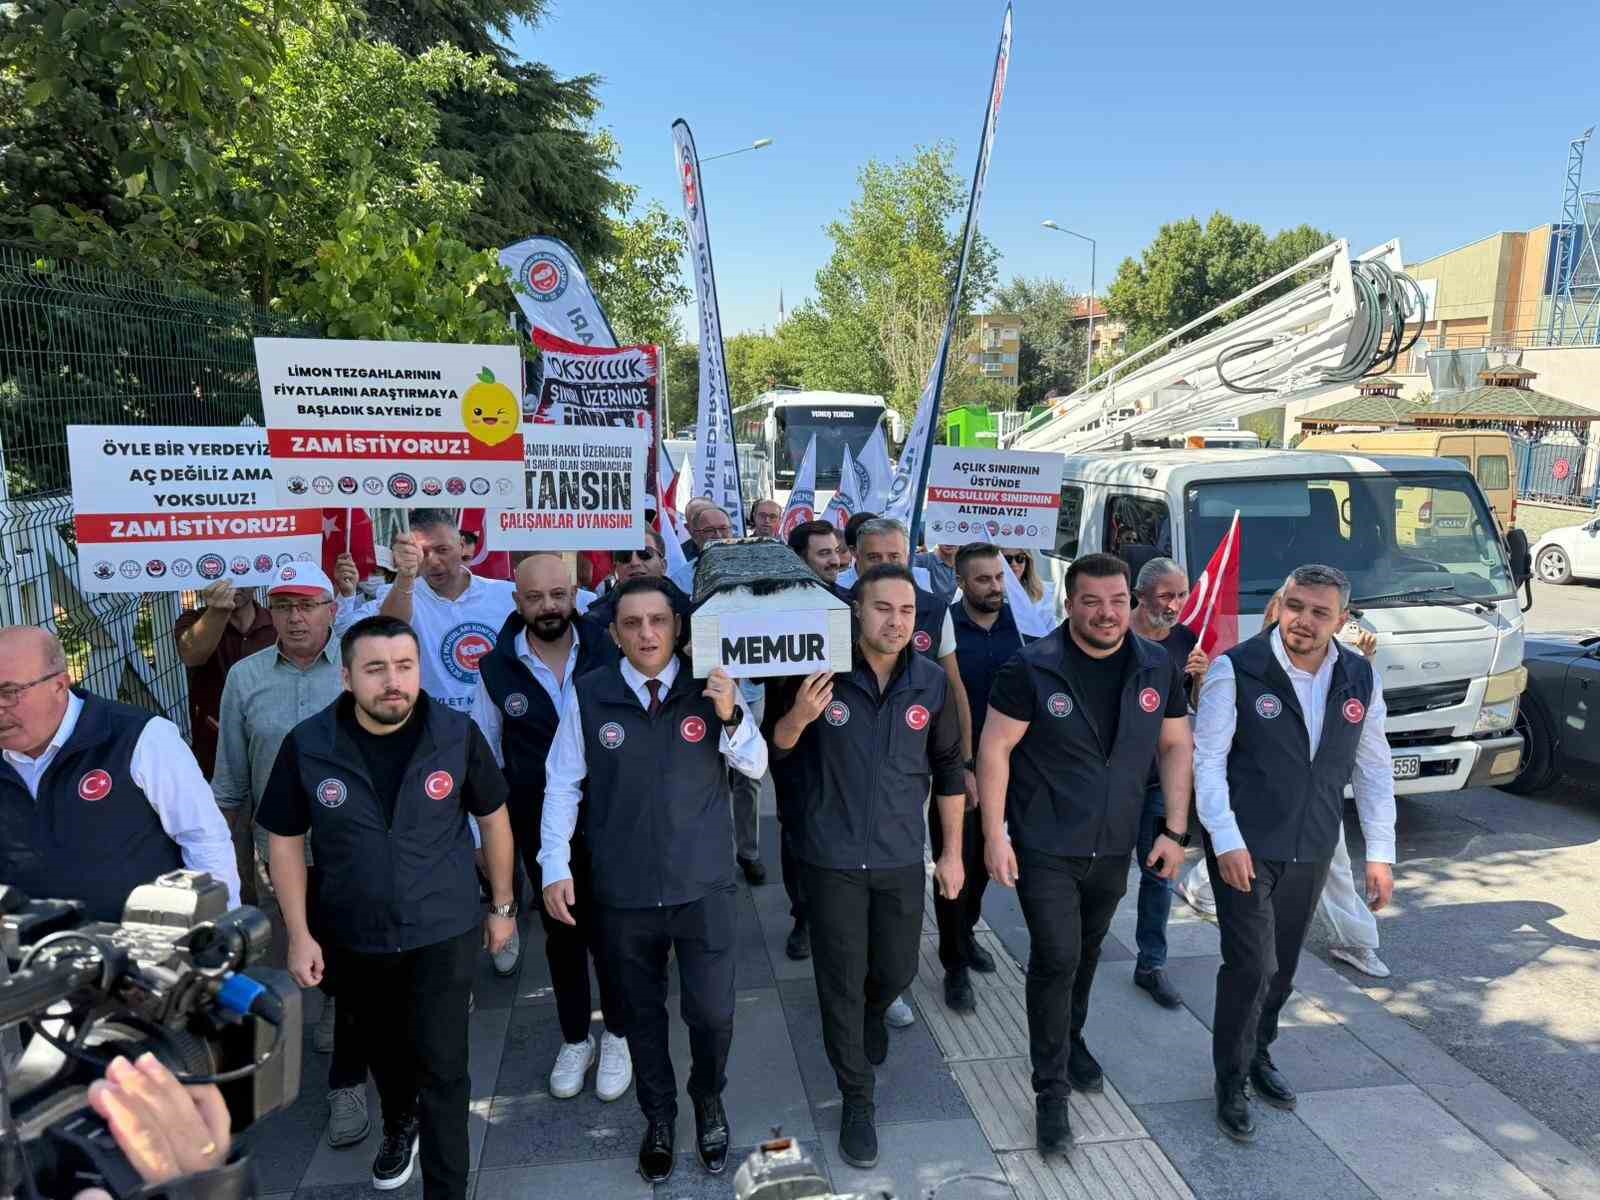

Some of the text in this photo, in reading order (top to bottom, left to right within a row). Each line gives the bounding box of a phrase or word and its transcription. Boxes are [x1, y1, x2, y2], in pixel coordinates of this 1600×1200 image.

[287, 364, 442, 380] LİMON TEZGAHLARININ
[547, 355, 645, 380] OKSULLUK
[273, 382, 459, 400] FİYATLARINI ARAŞTIRMAYA
[581, 385, 650, 407] ÜZERİNDE
[297, 404, 442, 418] BAŞLADIK SAYENİZ DE
[102, 439, 271, 456] ÖYLE BİR YERDEYİZ
[290, 433, 471, 454] ZAM İSTİYORUZ!
[551, 444, 581, 458] HAKKI
[582, 443, 633, 458] ÜZERİNDEN
[532, 458, 559, 470] SAHİBİ
[559, 460, 580, 471] OLAN
[953, 462, 1041, 476] AÇLIK SINIRININ
[129, 465, 273, 486] AÇ DEĞİLİZ AMA
[969, 475, 1022, 489] ÜSTÜNDE
[523, 470, 633, 511] TANSIN
[934, 489, 1053, 505] YOKSULLUK SINIRININ
[153, 492, 257, 507] YOKSULUZ!
[957, 504, 1028, 518] ALTINDAYIZ!
[109, 514, 297, 538] ZAM İSTİYORUZ!
[499, 512, 634, 533] ÇALIŞANLAR UYANSIN!
[720, 632, 826, 666] MEMUR
[1393, 759, 1417, 775] 558
